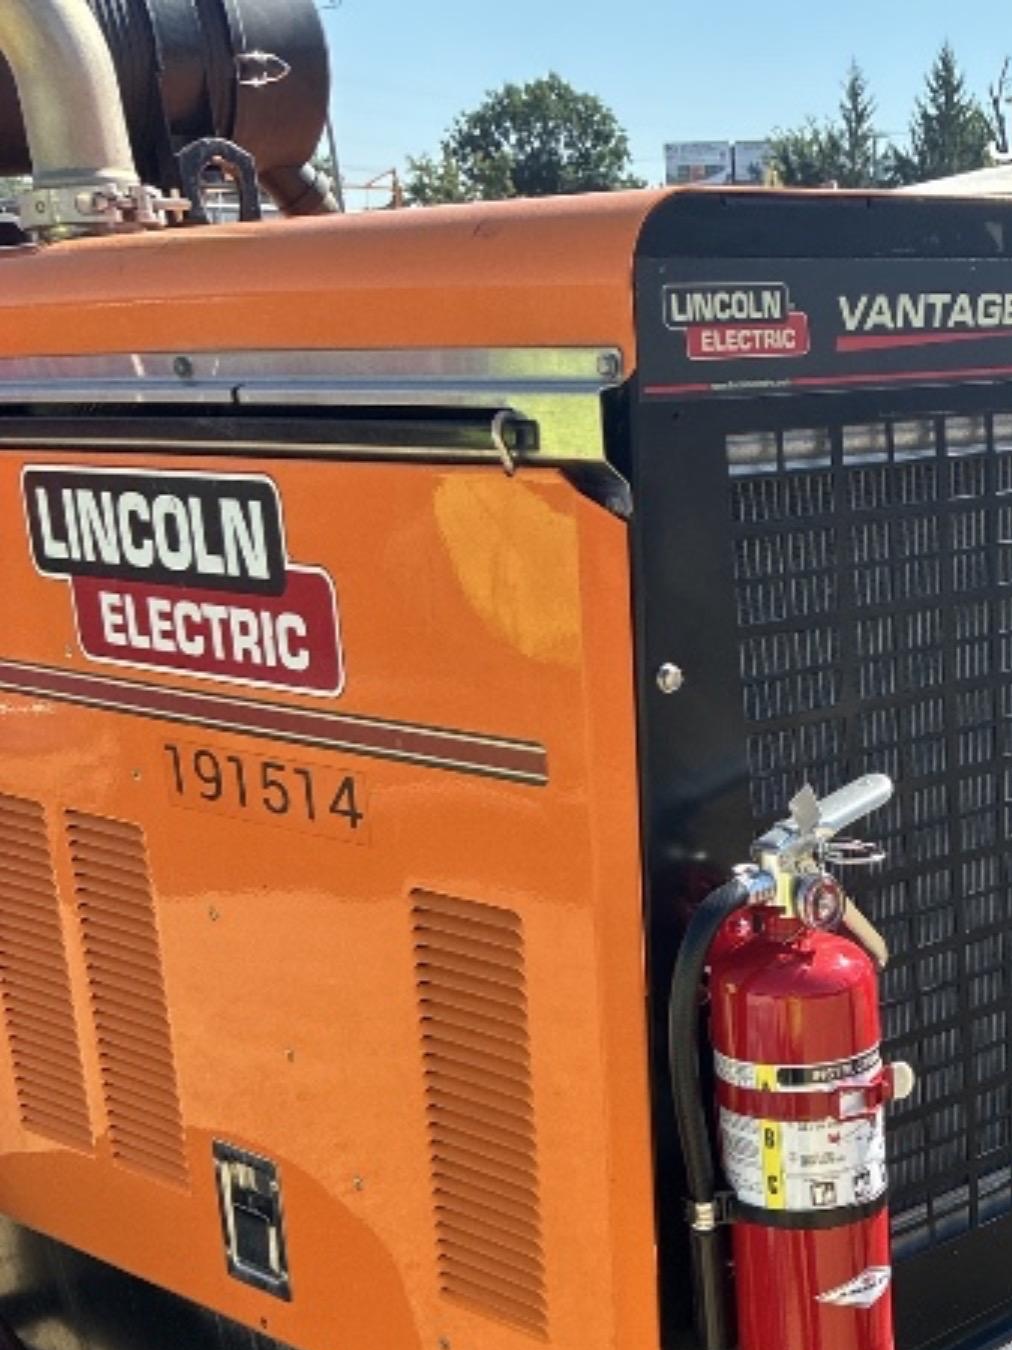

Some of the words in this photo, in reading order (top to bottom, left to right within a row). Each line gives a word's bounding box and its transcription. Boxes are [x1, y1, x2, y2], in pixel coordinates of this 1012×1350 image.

[670, 290, 782, 322] LINCOLN
[700, 327, 796, 352] ELECTRIC
[35, 487, 270, 579] LINCOLN
[98, 590, 311, 671] ELECTRIC
[163, 743, 364, 830] 191514
